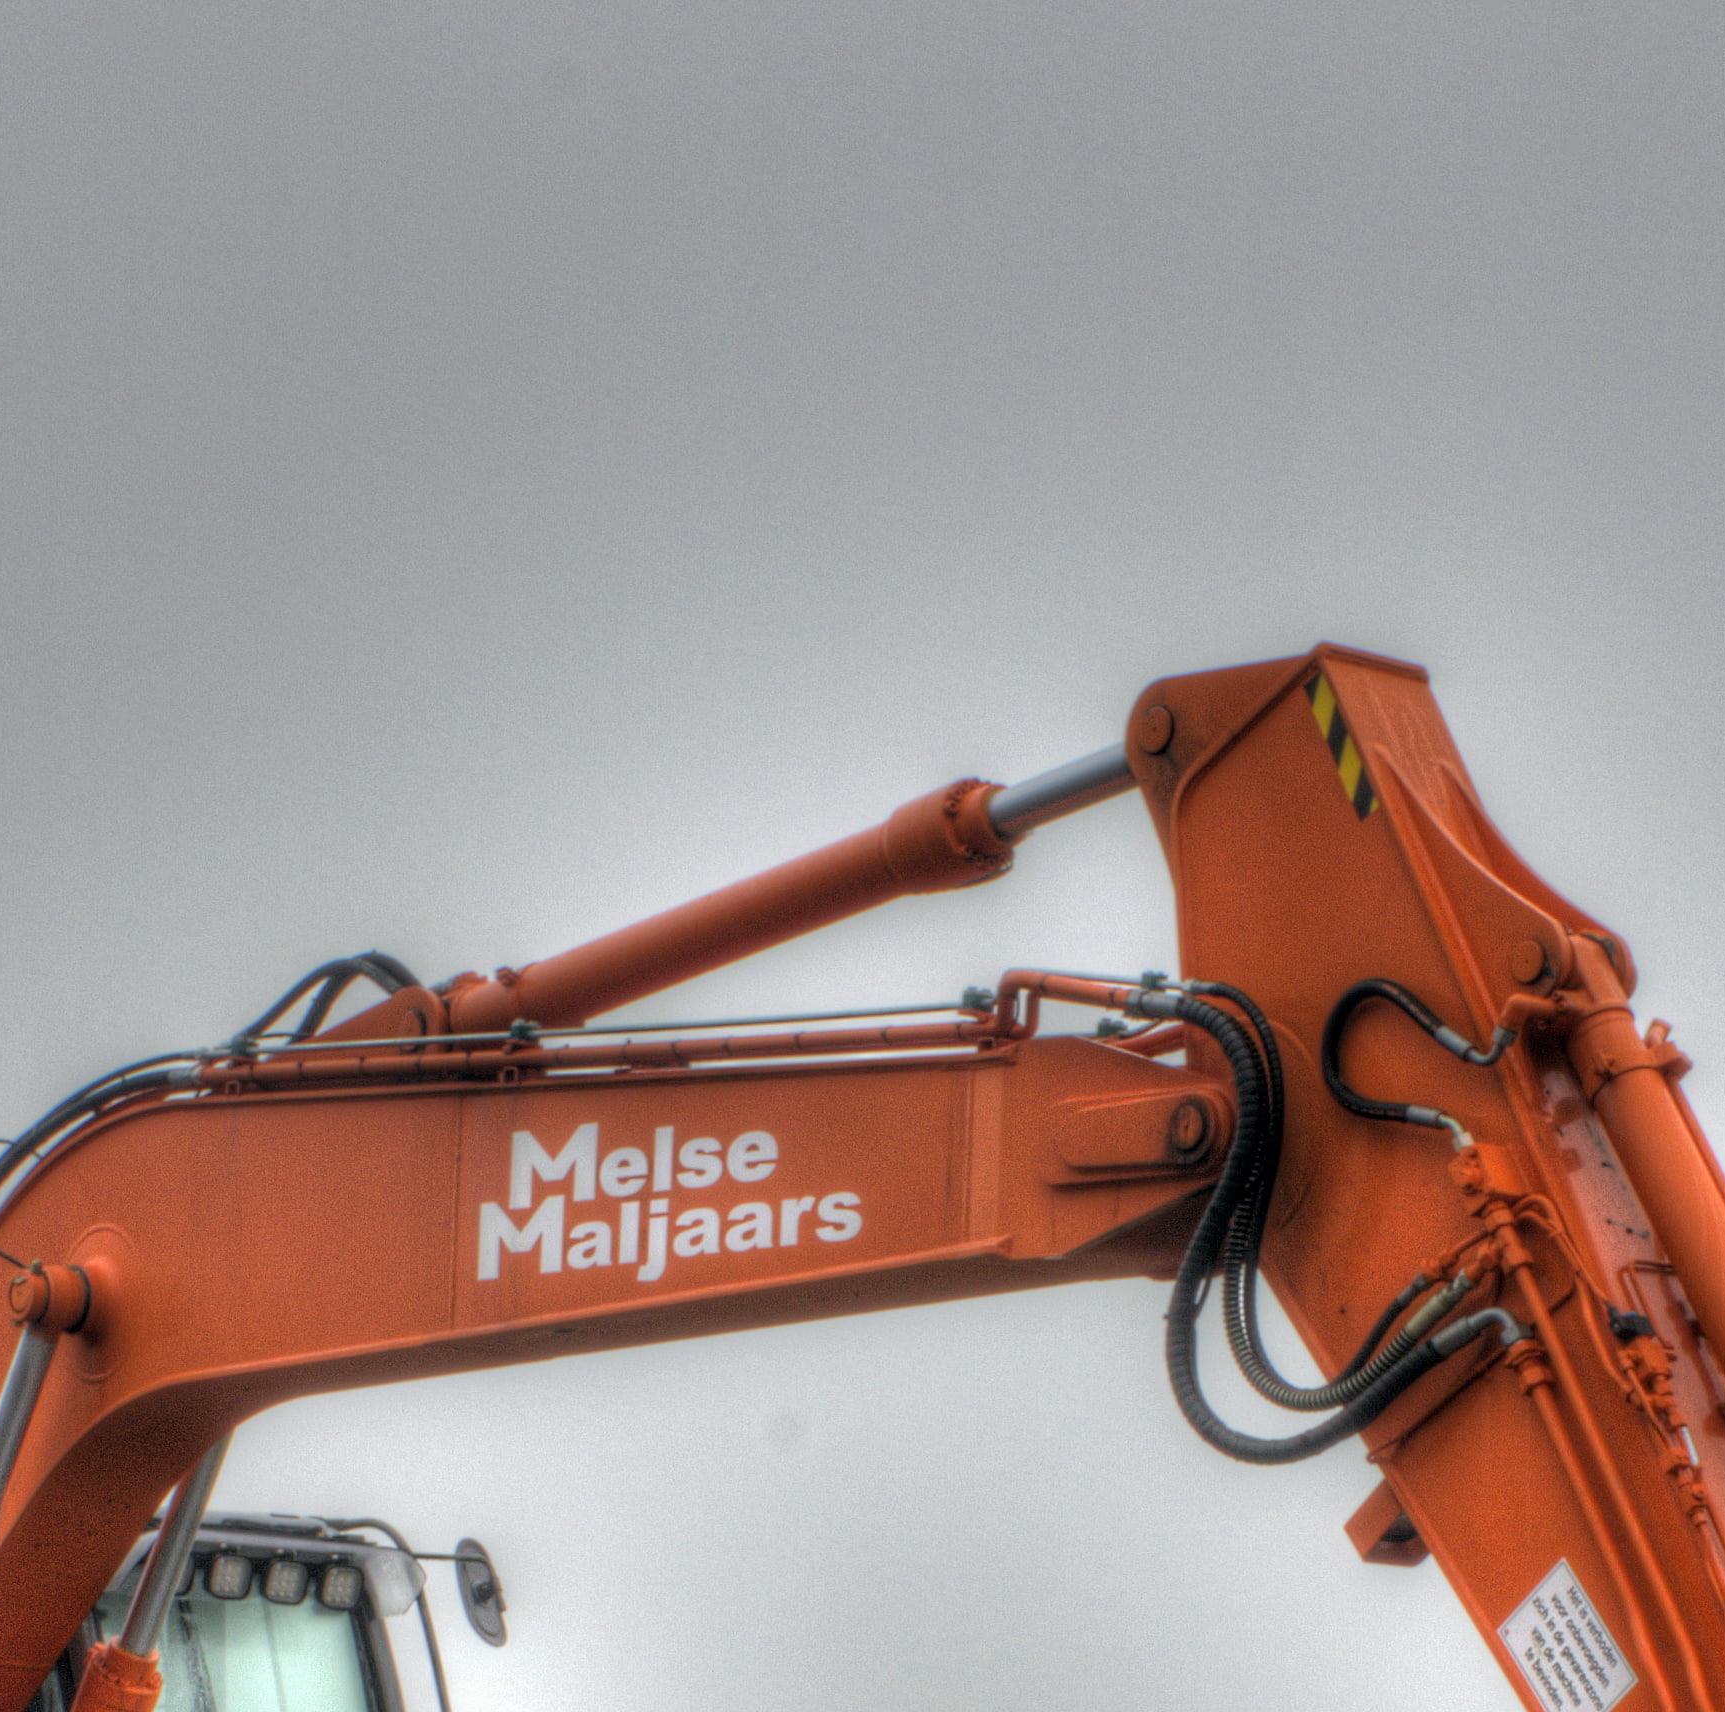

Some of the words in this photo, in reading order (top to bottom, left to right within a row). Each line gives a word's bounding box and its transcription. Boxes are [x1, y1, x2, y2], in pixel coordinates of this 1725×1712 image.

[509, 1122, 779, 1210] Melse
[477, 1191, 863, 1282] Maljaars
[1524, 1647, 1535, 1662] te
[1530, 1627, 1546, 1649] van
[1542, 1647, 1555, 1663] de
[1551, 1662, 1582, 1707] machine
[1531, 1596, 1550, 1620] zich
[1545, 1618, 1557, 1632] in
[1552, 1630, 1565, 1647] de
[1560, 1646, 1604, 1712] gevarenzone
[1550, 1594, 1569, 1618] voor
[1565, 1619, 1611, 1689] onbevoegden
[1566, 1585, 1584, 1609] Het
[1577, 1605, 1590, 1620] is
[1585, 1618, 1619, 1669] verboden
